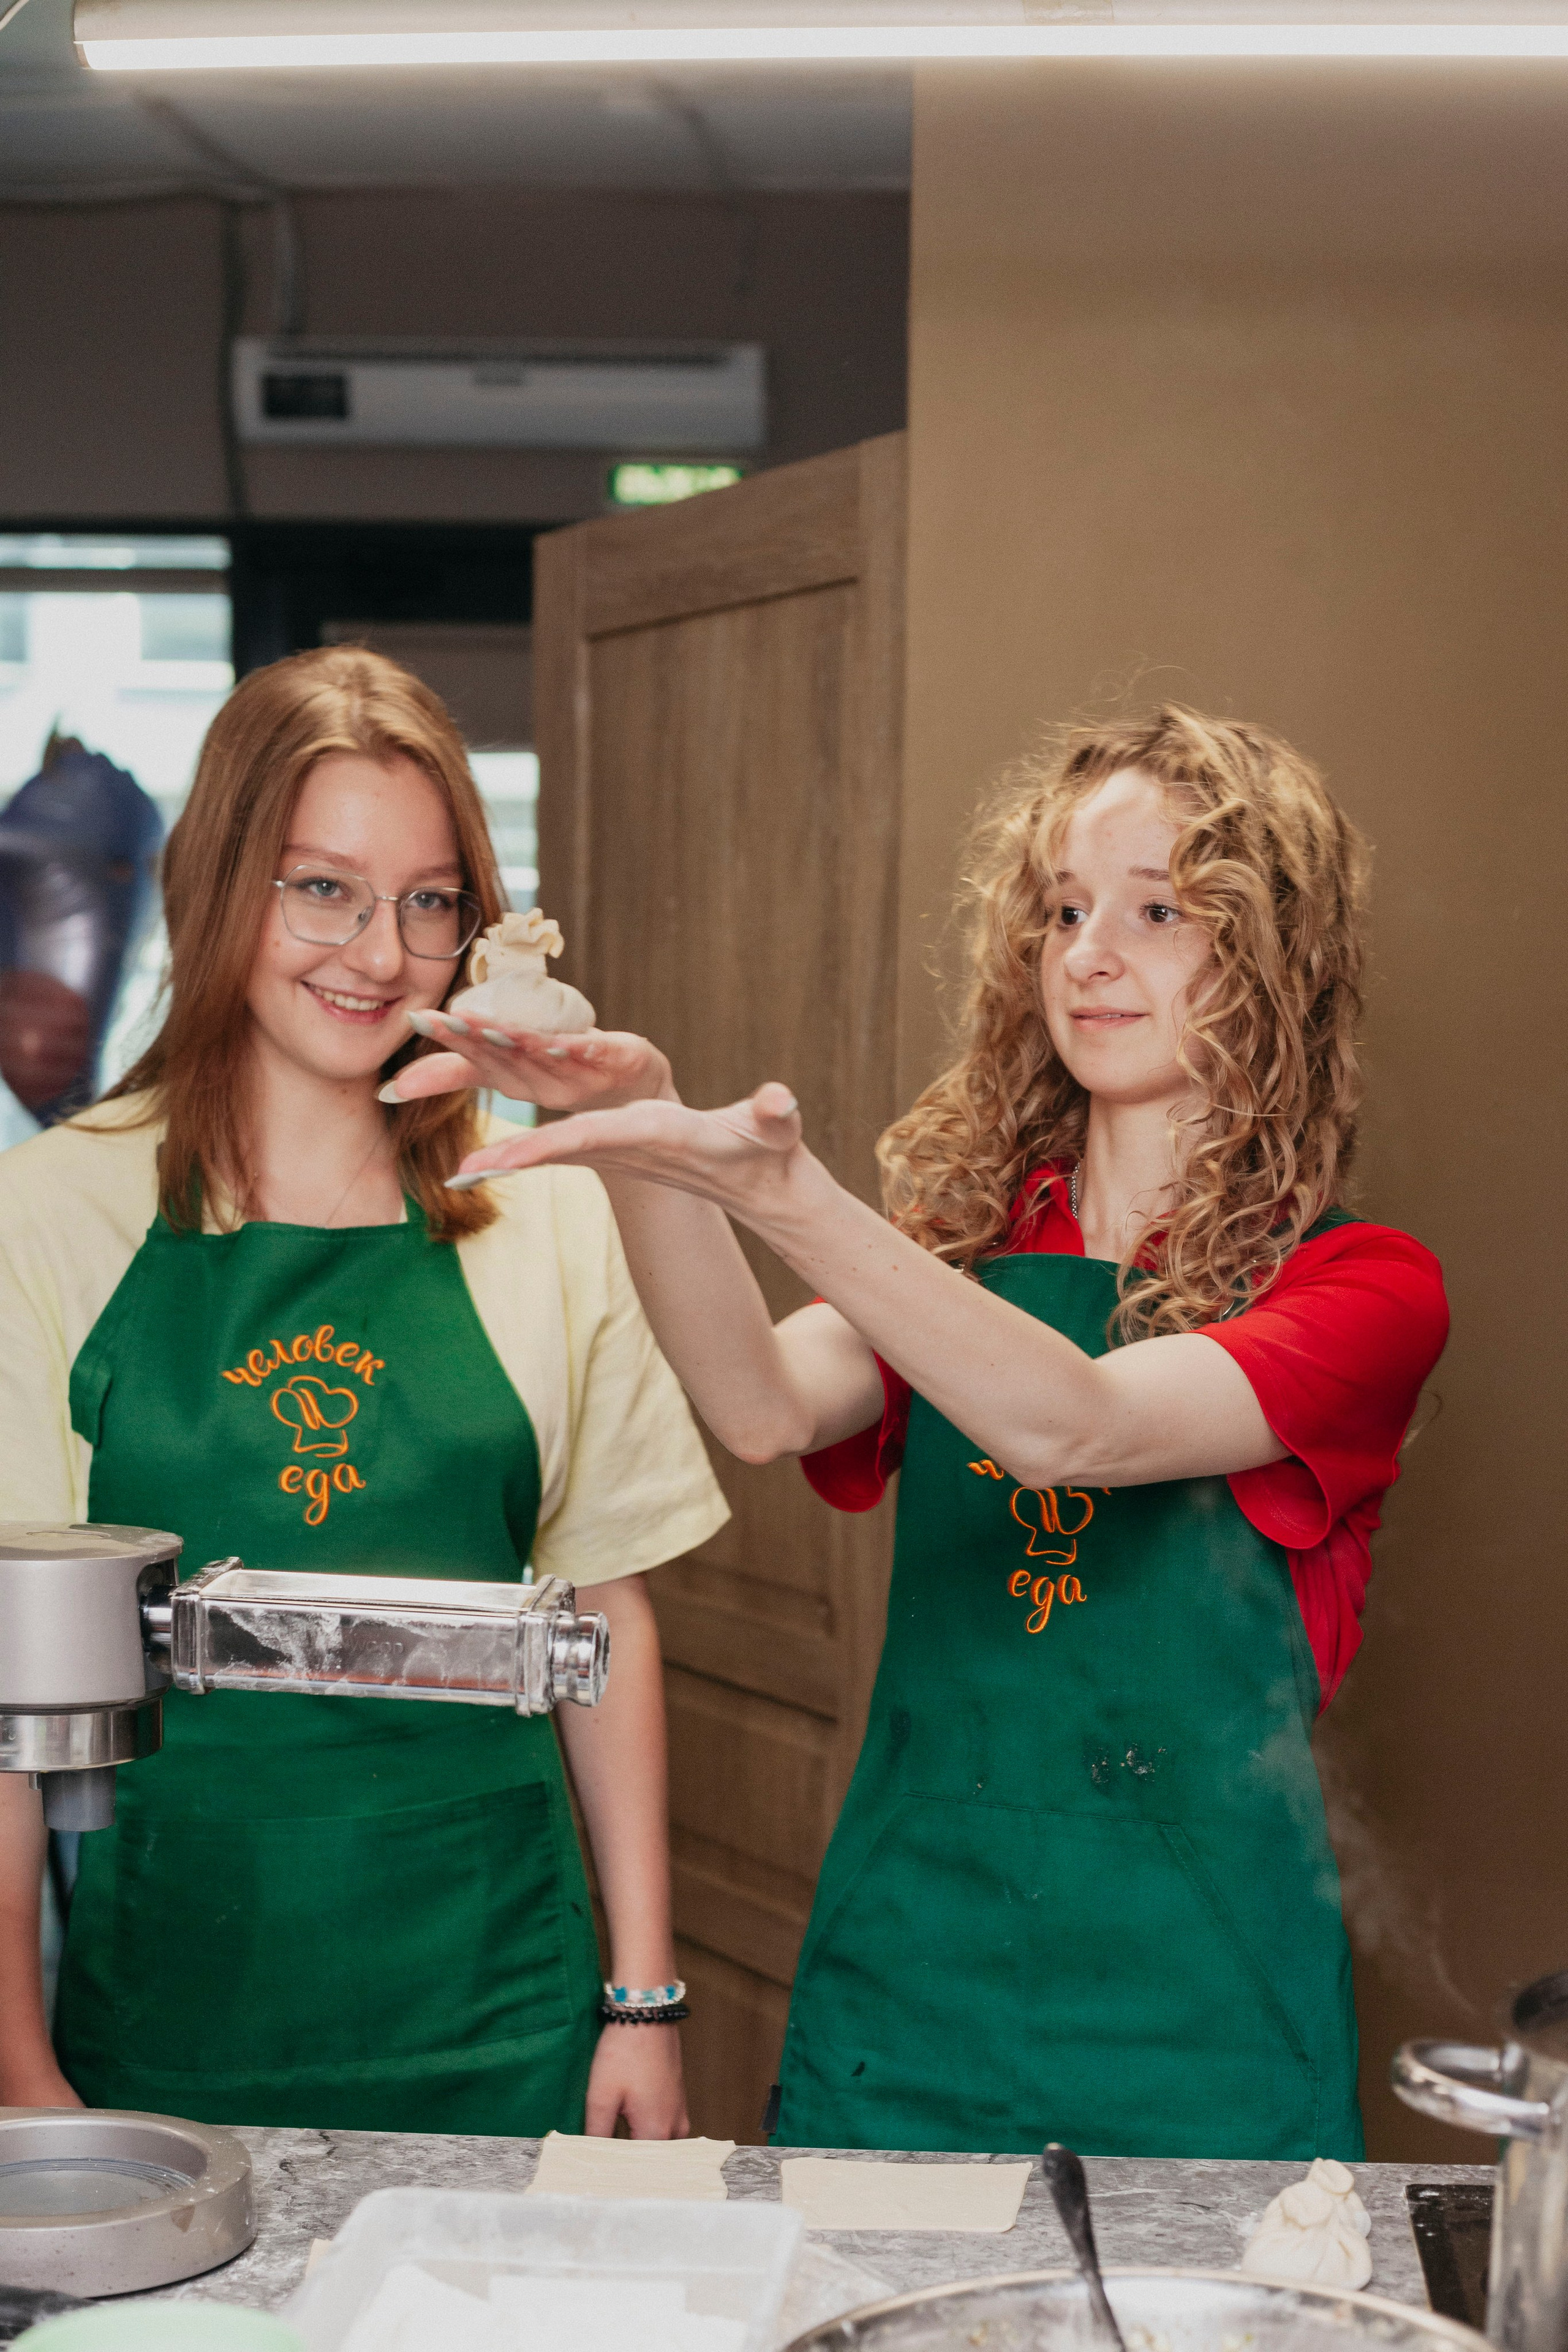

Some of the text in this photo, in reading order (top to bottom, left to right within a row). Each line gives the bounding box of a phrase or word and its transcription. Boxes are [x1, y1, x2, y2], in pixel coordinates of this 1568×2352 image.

[222, 1324, 385, 1387] человек
[279, 1462, 367, 1527] еда
[1008, 1569, 1087, 1635] еда
